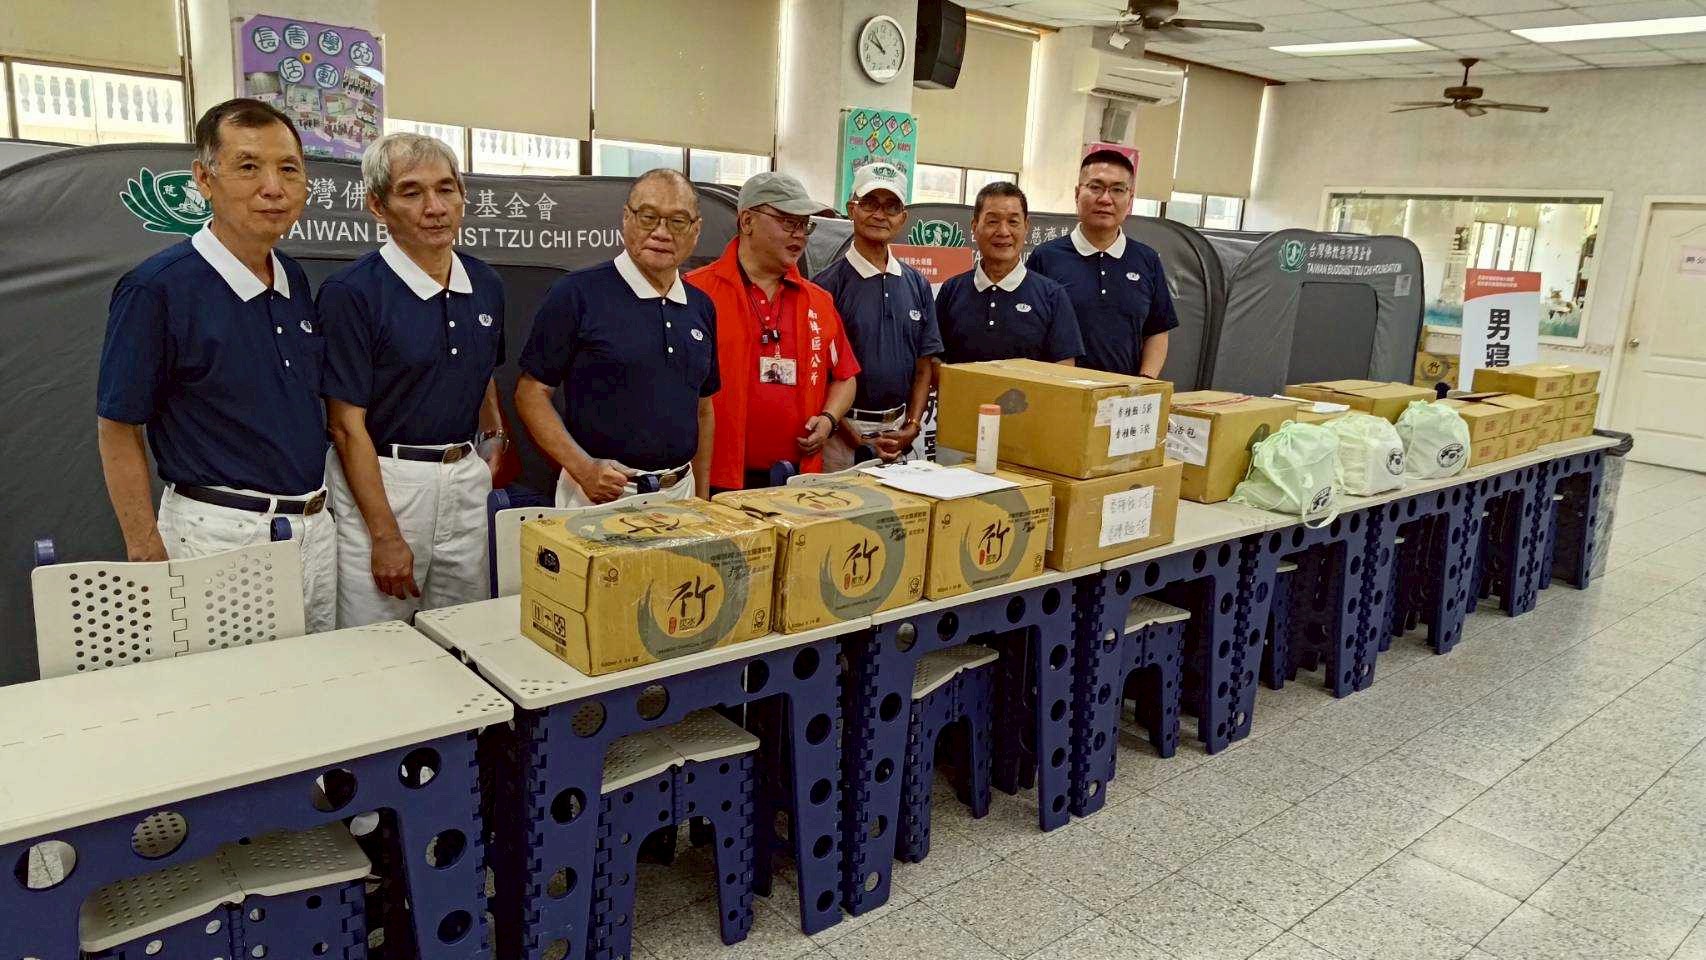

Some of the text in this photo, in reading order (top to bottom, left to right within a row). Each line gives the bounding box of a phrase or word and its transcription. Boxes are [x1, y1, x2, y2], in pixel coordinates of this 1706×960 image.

[280, 220, 369, 242] AIWAN
[495, 228, 533, 248] TZU
[539, 230, 571, 249] CHI
[842, 538, 880, 585] 竹
[978, 519, 1011, 563] 竹
[667, 575, 716, 627] 竹
